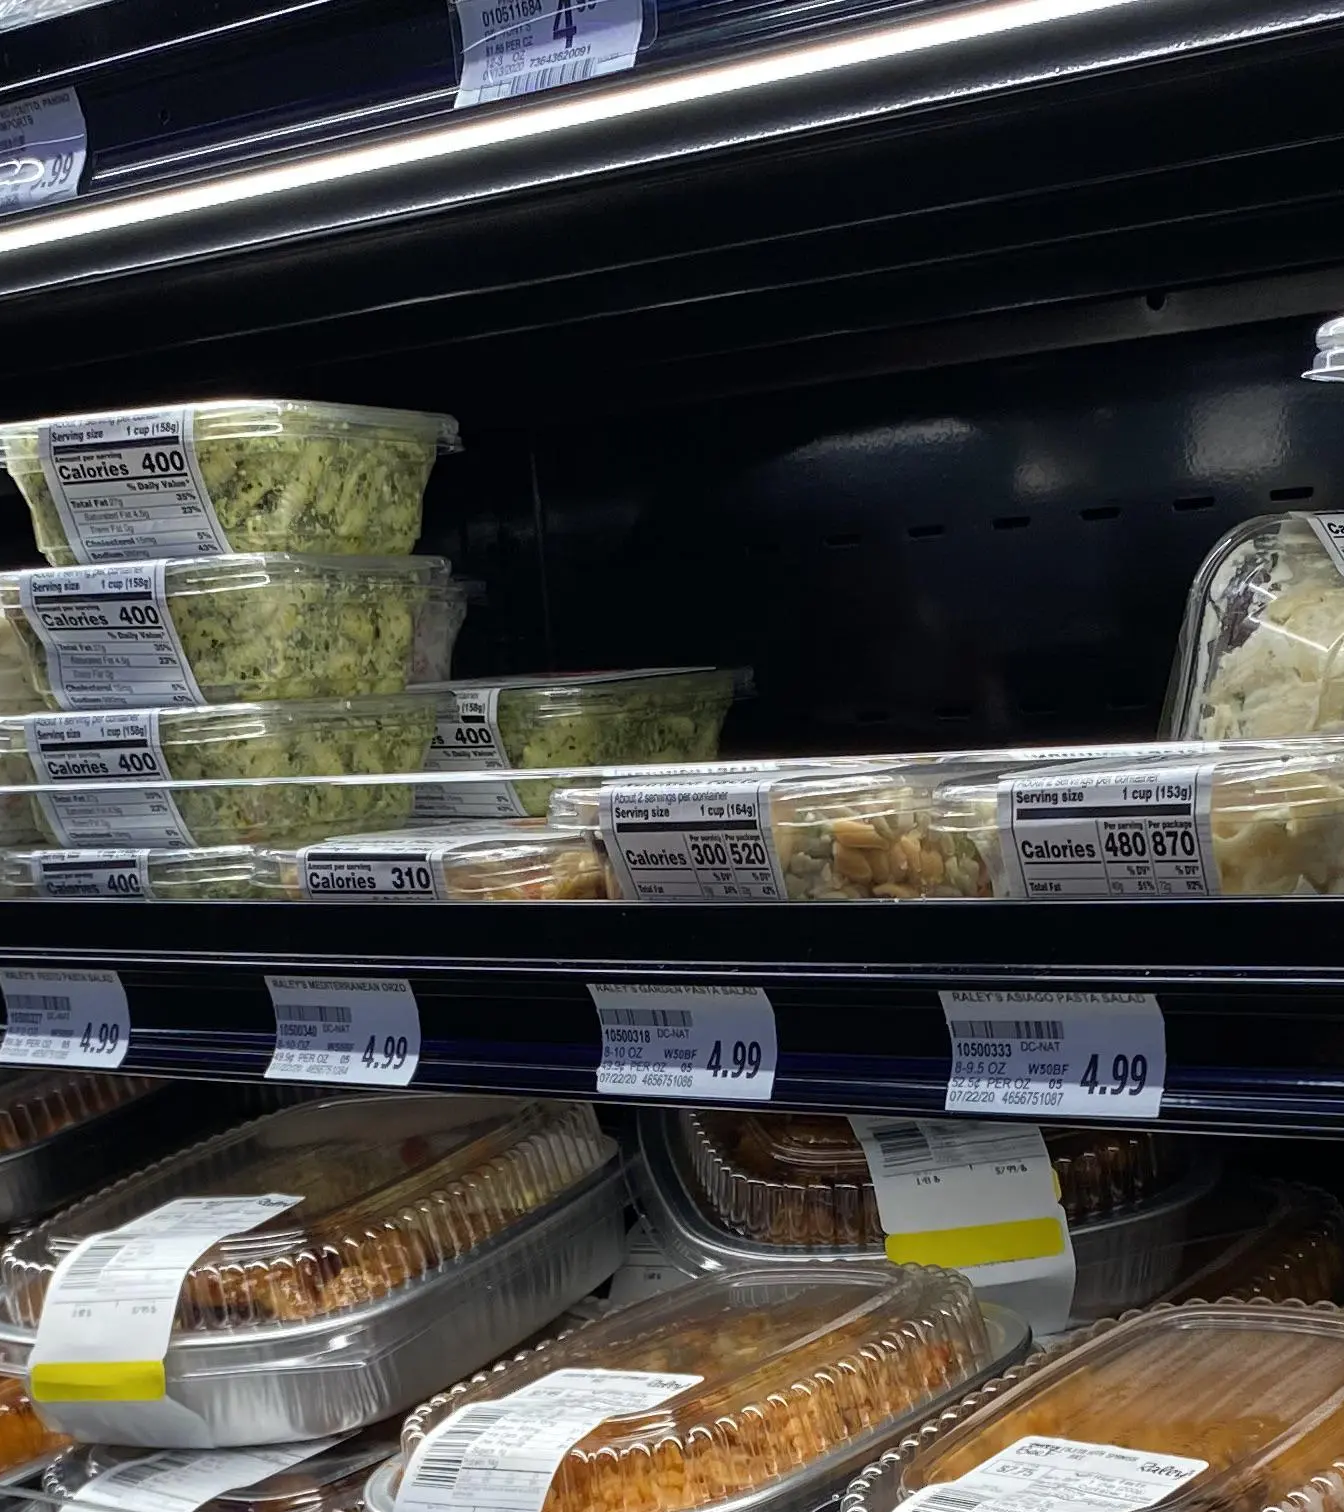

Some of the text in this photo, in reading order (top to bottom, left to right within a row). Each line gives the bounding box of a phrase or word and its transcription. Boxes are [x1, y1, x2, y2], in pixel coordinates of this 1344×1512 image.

[58, 451, 185, 481] Calories 400
[42, 606, 158, 628] Calories 400
[455, 726, 492, 745] 400
[48, 752, 157, 775] Calories 400
[626, 843, 766, 865] Calories 300 520
[1022, 830, 1195, 858] Calories 480 870
[107, 873, 141, 894] 400
[308, 867, 431, 891] Calories 310
[79, 1022, 120, 1055] 4.99
[361, 1035, 408, 1069] 4.99
[707, 1040, 761, 1079] 4.99
[988, 1062, 1006, 1075] OZ
[1080, 1053, 1147, 1096] 4.99
